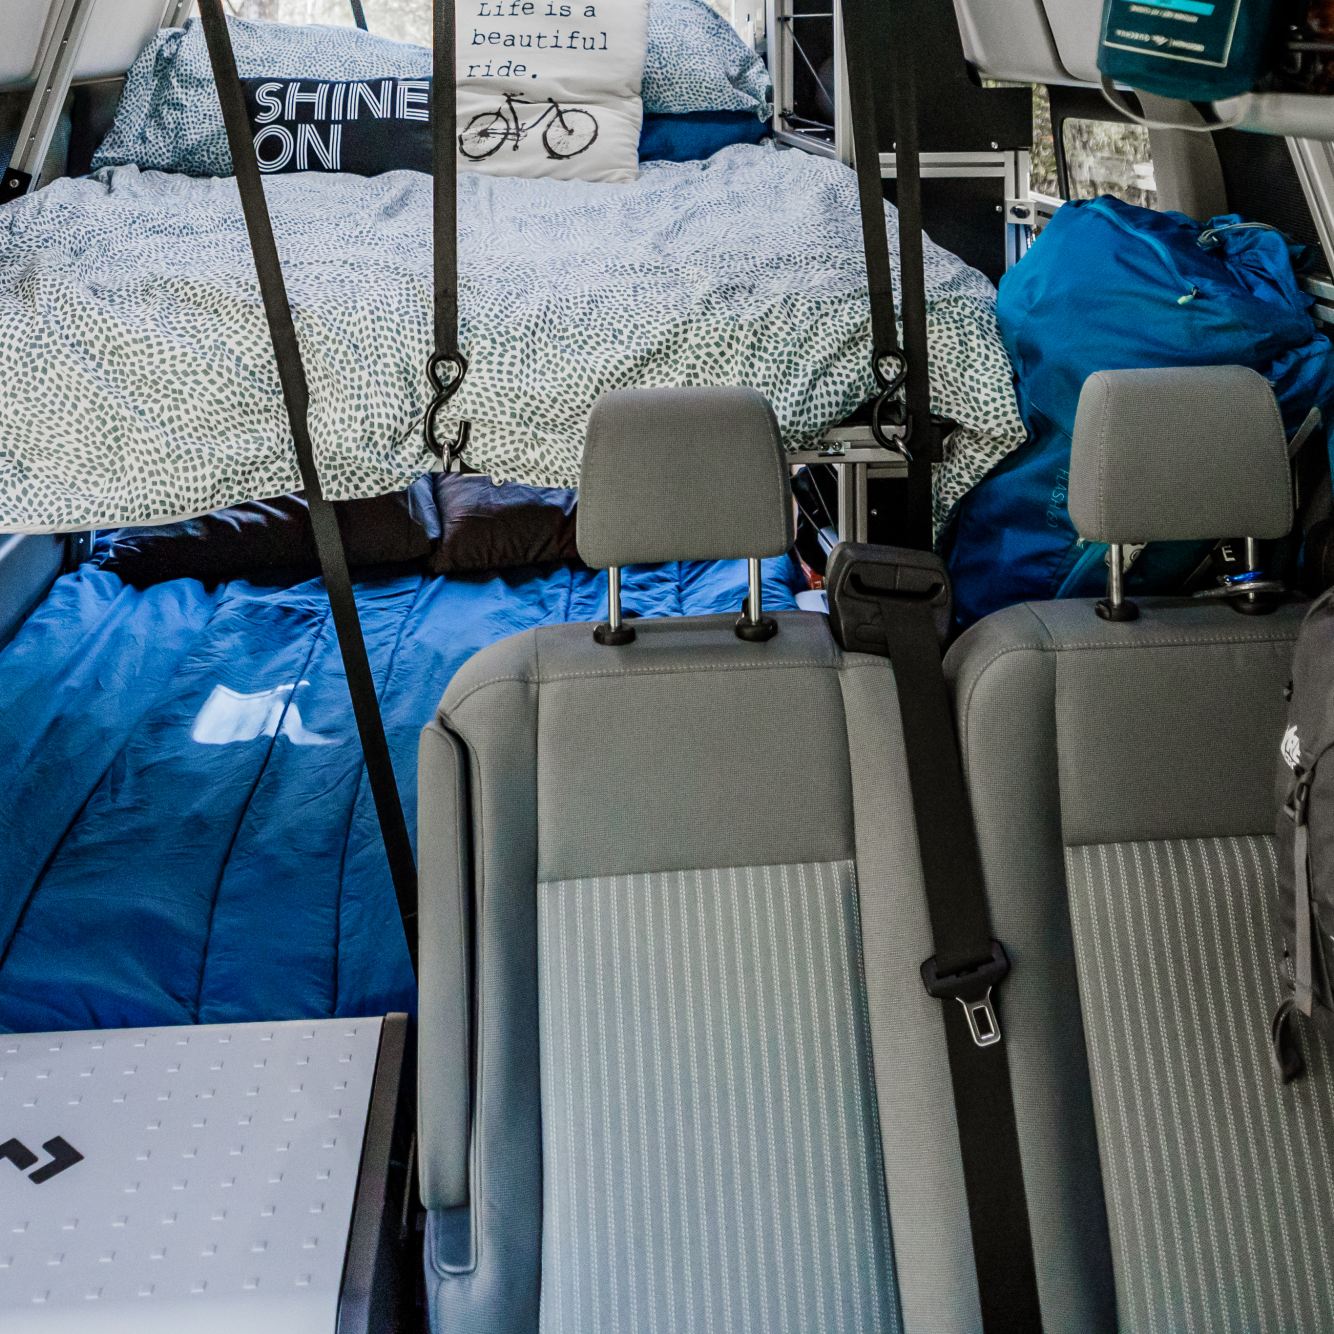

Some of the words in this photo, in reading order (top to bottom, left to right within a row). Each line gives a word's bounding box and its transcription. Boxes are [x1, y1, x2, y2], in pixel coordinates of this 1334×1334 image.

[477, 0, 534, 17] Life
[544, 1, 572, 17] is
[583, 5, 596, 17] a
[471, 29, 608, 50] beautiful
[467, 59, 537, 79] ride.
[254, 80, 429, 124] SHINE
[253, 123, 342, 172] ON
[1049, 467, 1070, 510] FLASH
